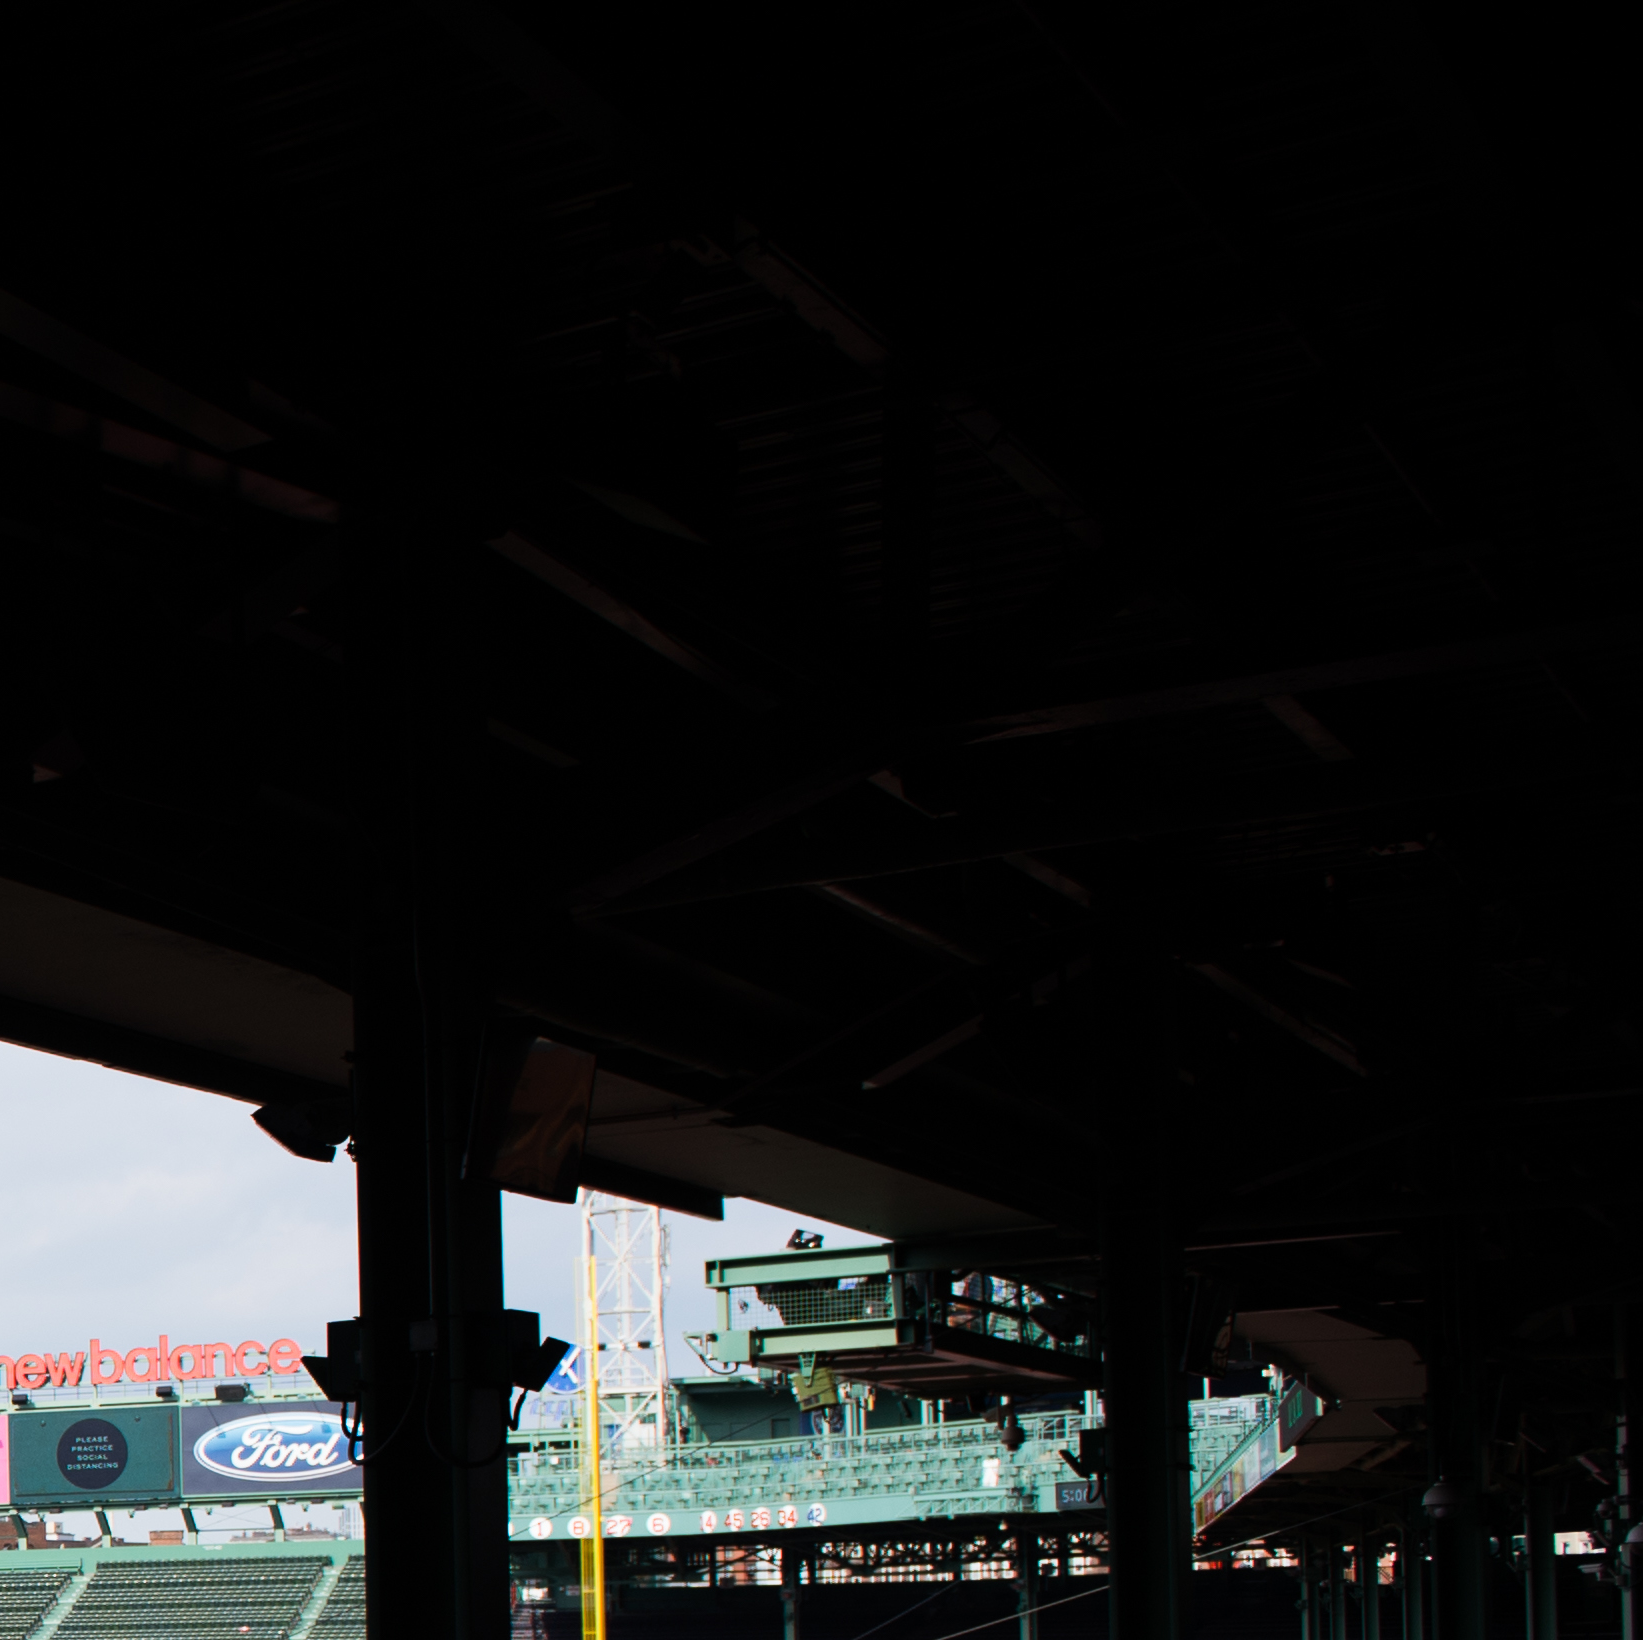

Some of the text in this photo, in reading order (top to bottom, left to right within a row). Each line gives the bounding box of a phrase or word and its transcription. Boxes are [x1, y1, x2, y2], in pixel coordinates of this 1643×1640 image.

[90, 1334, 302, 1384] balance
[75, 1436, 108, 1444] PLEASE
[231, 1425, 337, 1469] Ford
[67, 1462, 119, 1470] DISTANCING
[724, 1512, 743, 1528] 45
[777, 1509, 796, 1526] 34
[807, 1507, 823, 1523] 42
[605, 1518, 631, 1535] 27
[653, 1517, 664, 1532] 6
